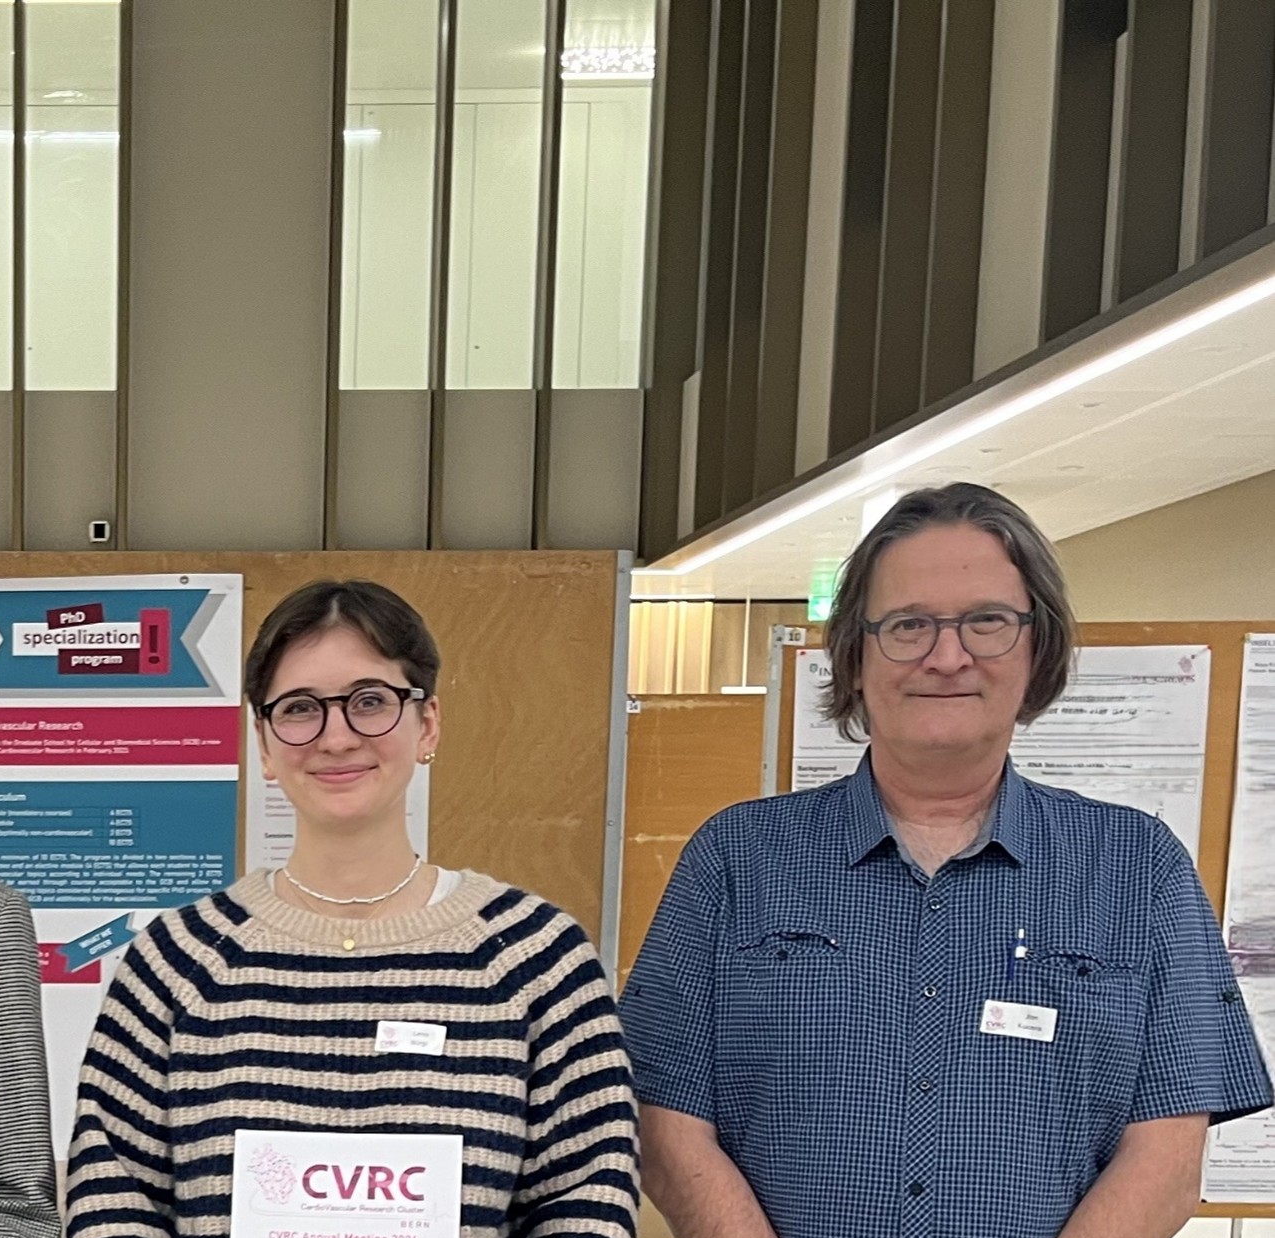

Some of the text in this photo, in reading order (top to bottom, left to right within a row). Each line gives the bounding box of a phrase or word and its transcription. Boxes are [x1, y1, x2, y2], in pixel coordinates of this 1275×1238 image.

[59, 612, 86, 625] PhD
[23, 630, 140, 648] specialization
[71, 653, 123, 667] program
[38, 721, 84, 730] Research
[78, 927, 112, 948] WHAT WE
[89, 939, 112, 955] OFFER
[302, 1164, 426, 1202] CVRC
[397, 1206, 425, 1214] Cluster
[400, 1221, 430, 1229] BERN
